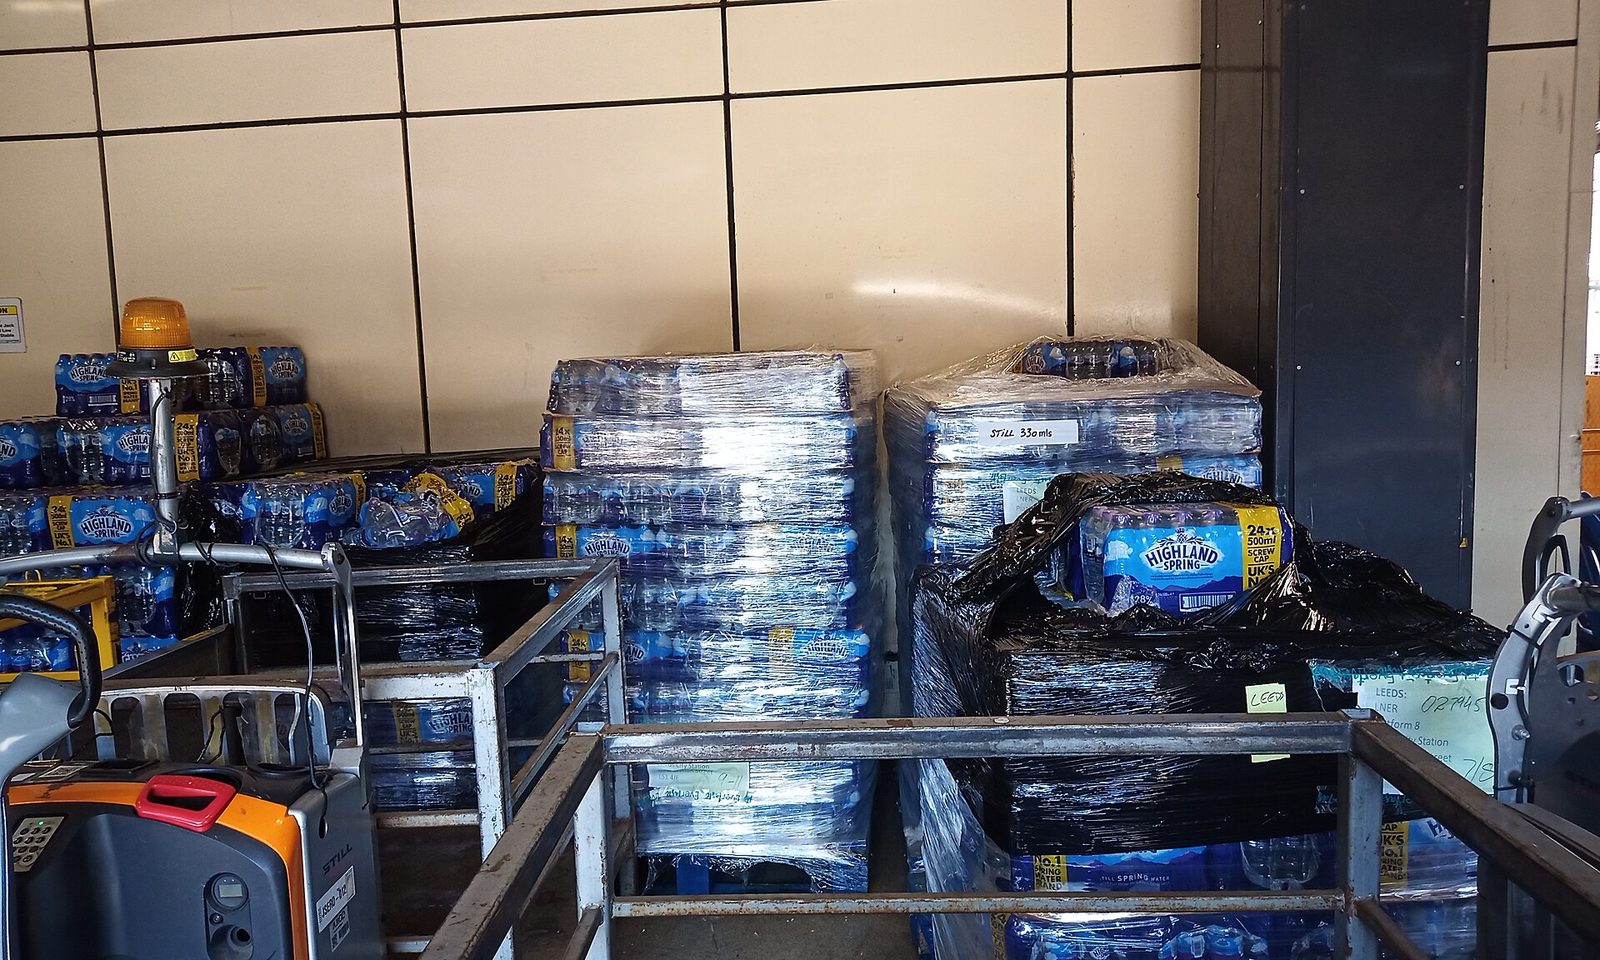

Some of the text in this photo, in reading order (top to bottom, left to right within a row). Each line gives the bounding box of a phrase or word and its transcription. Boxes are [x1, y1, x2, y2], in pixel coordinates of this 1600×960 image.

[70, 365, 107, 379] HIGHLAN
[176, 422, 195, 430] 24x
[80, 517, 132, 535] HIGHLAND
[1247, 524, 1277, 536] 24x
[94, 529, 121, 538] SPRING
[1247, 535, 1277, 546] 500ml
[584, 541, 631, 556] HIGHLAND
[1247, 547, 1276, 557] SCREW
[1145, 544, 1219, 567] HIGHLAND
[1253, 555, 1270, 563] CAP
[1163, 559, 1201, 571] SPRING
[1247, 564, 1275, 577] UK'S
[1375, 687, 1408, 699] LEEDS:
[1414, 720, 1421, 731] 8
[1417, 735, 1450, 748] Station
[322, 843, 353, 876] STILL
[1034, 855, 1061, 868] No.1
[1035, 873, 1062, 883] WATER
[1117, 872, 1149, 882] SPRING
